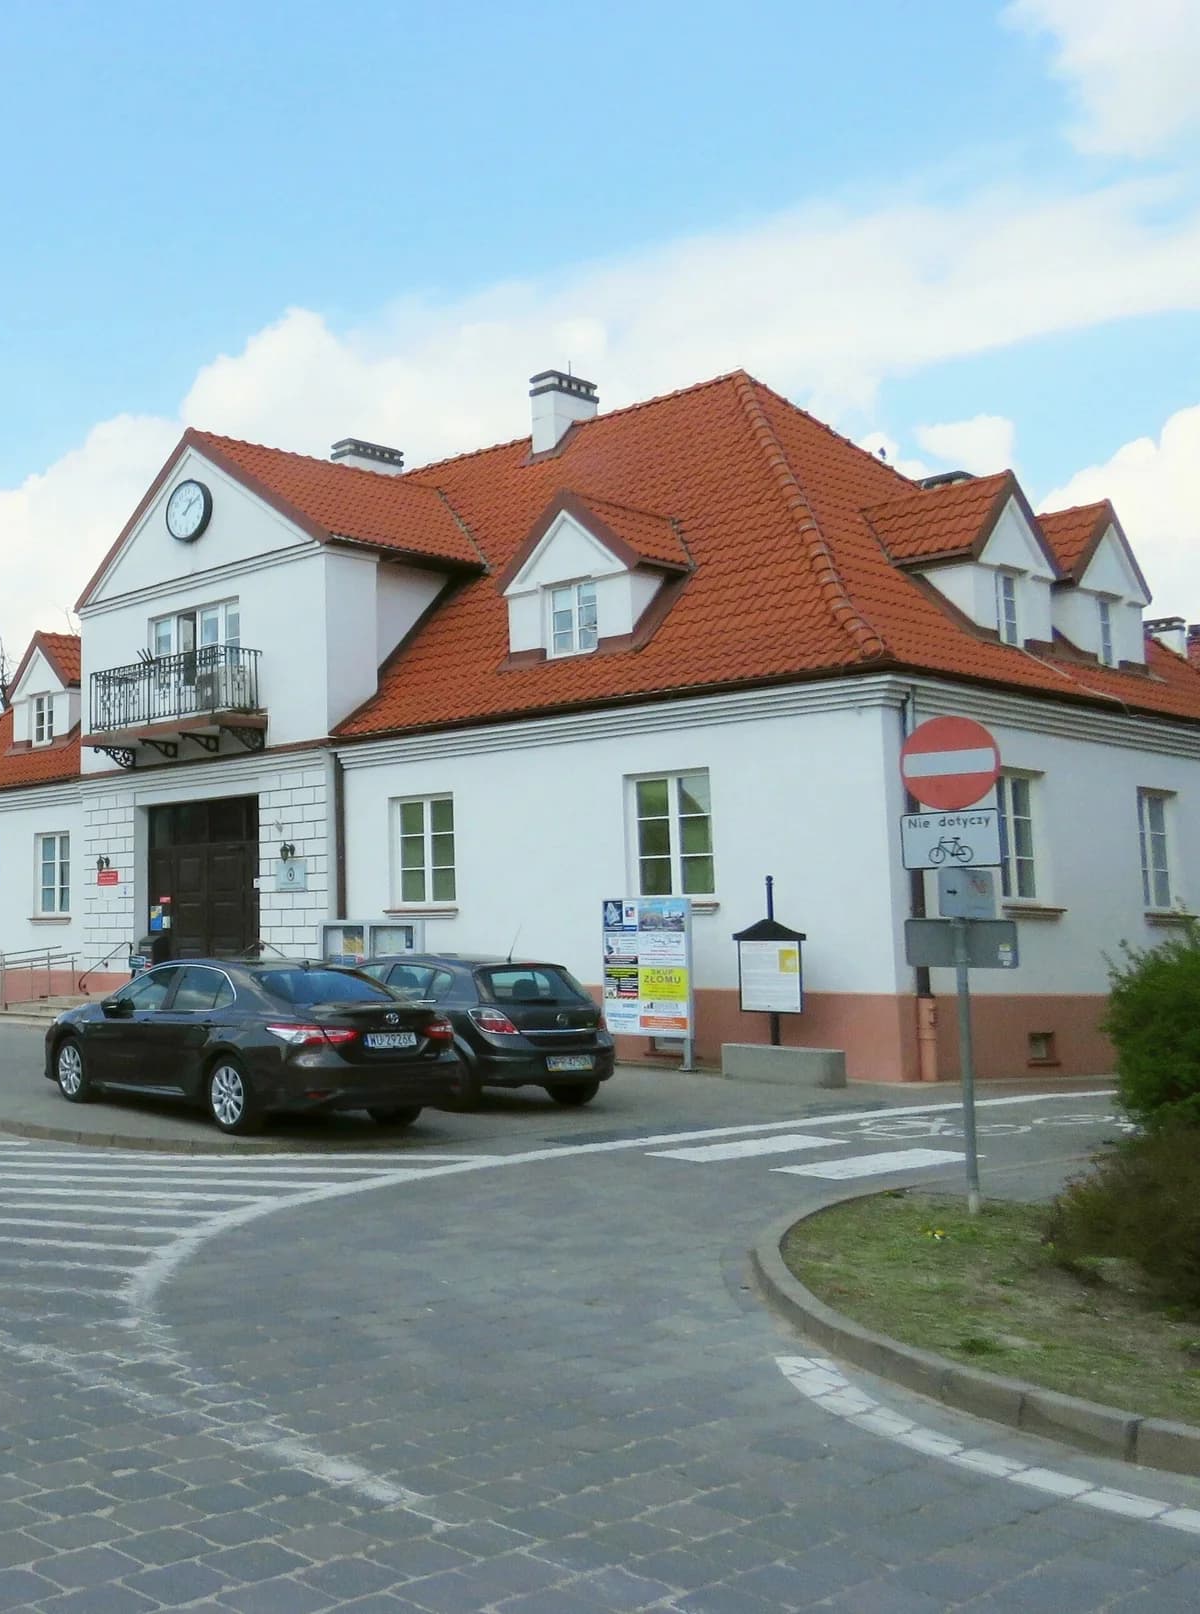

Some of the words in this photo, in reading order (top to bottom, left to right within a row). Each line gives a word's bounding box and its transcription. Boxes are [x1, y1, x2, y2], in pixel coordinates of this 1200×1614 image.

[908, 819, 931, 829] Nie
[938, 815, 991, 828] dotyczy
[643, 975, 681, 984] ZŁOMU
